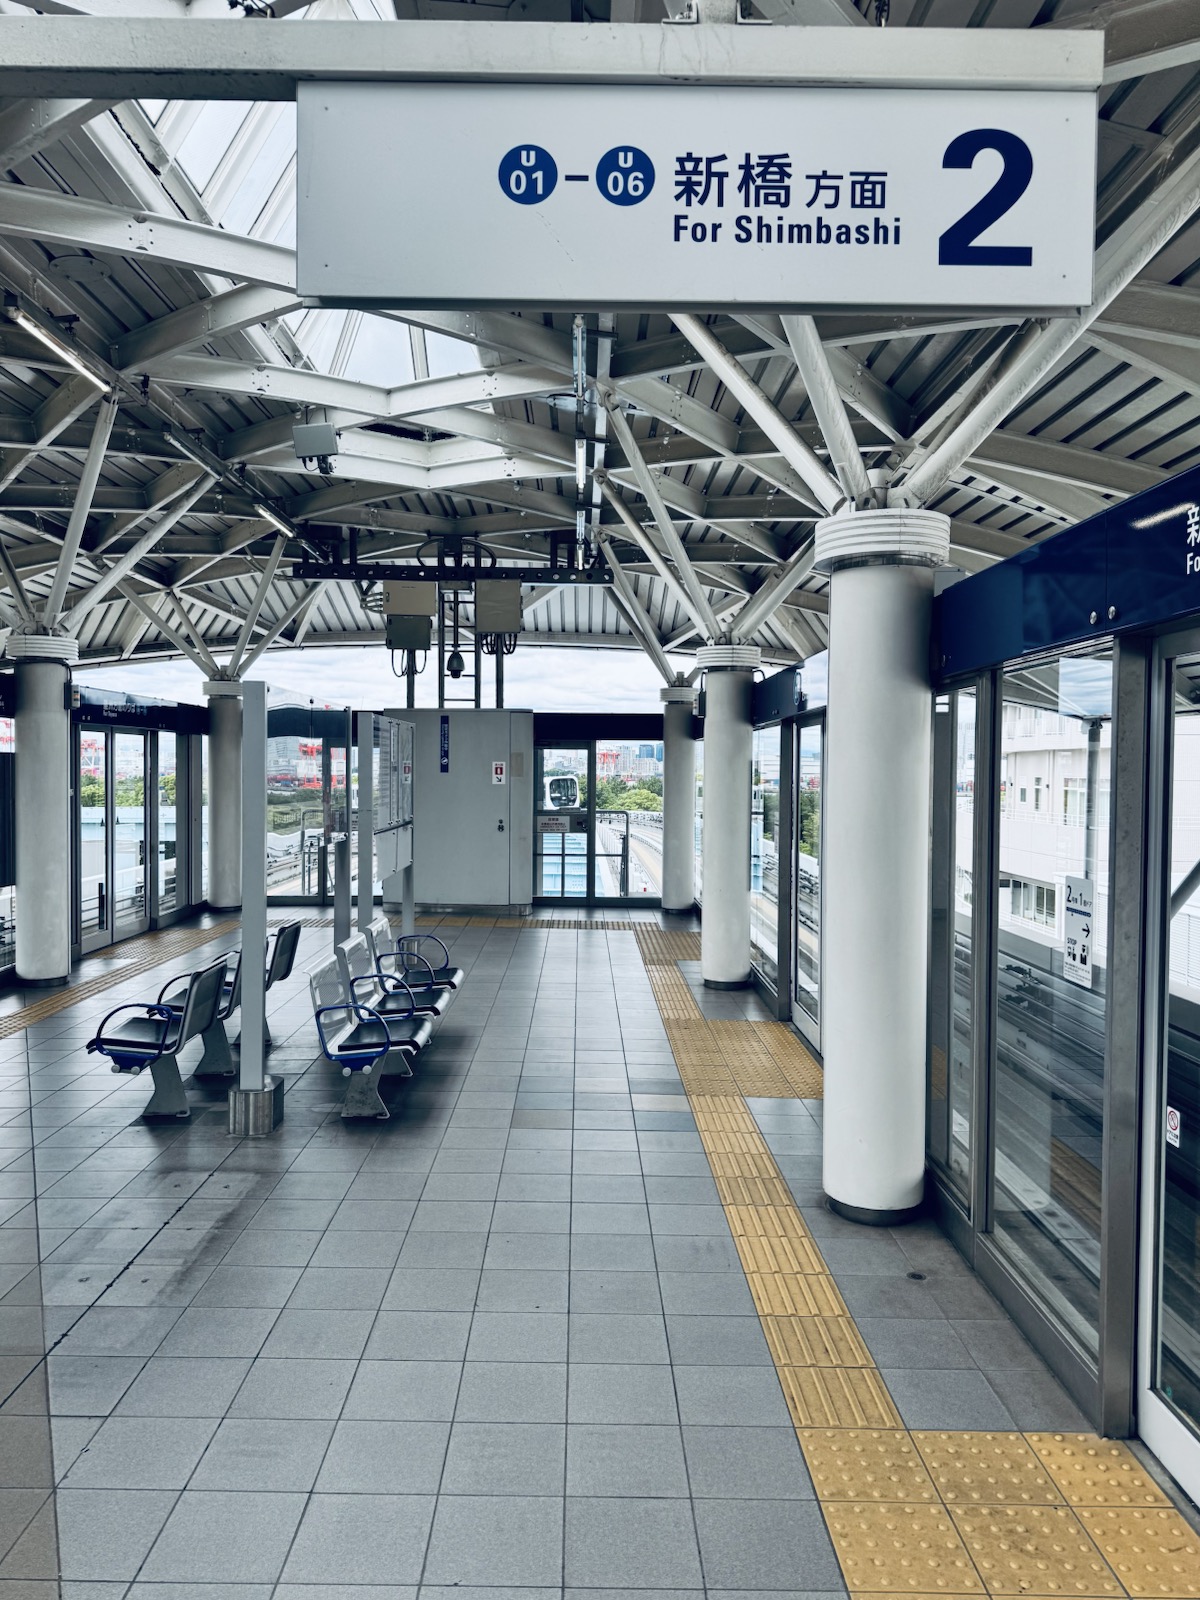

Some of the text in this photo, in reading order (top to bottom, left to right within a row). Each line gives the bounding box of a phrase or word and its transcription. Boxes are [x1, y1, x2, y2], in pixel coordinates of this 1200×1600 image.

[521, 151, 535, 166] U
[619, 152, 633, 167] U
[510, 170, 542, 195] 01
[608, 172, 645, 196] 06
[939, 129, 1033, 266] 2
[674, 215, 901, 245] For Shimbashi
